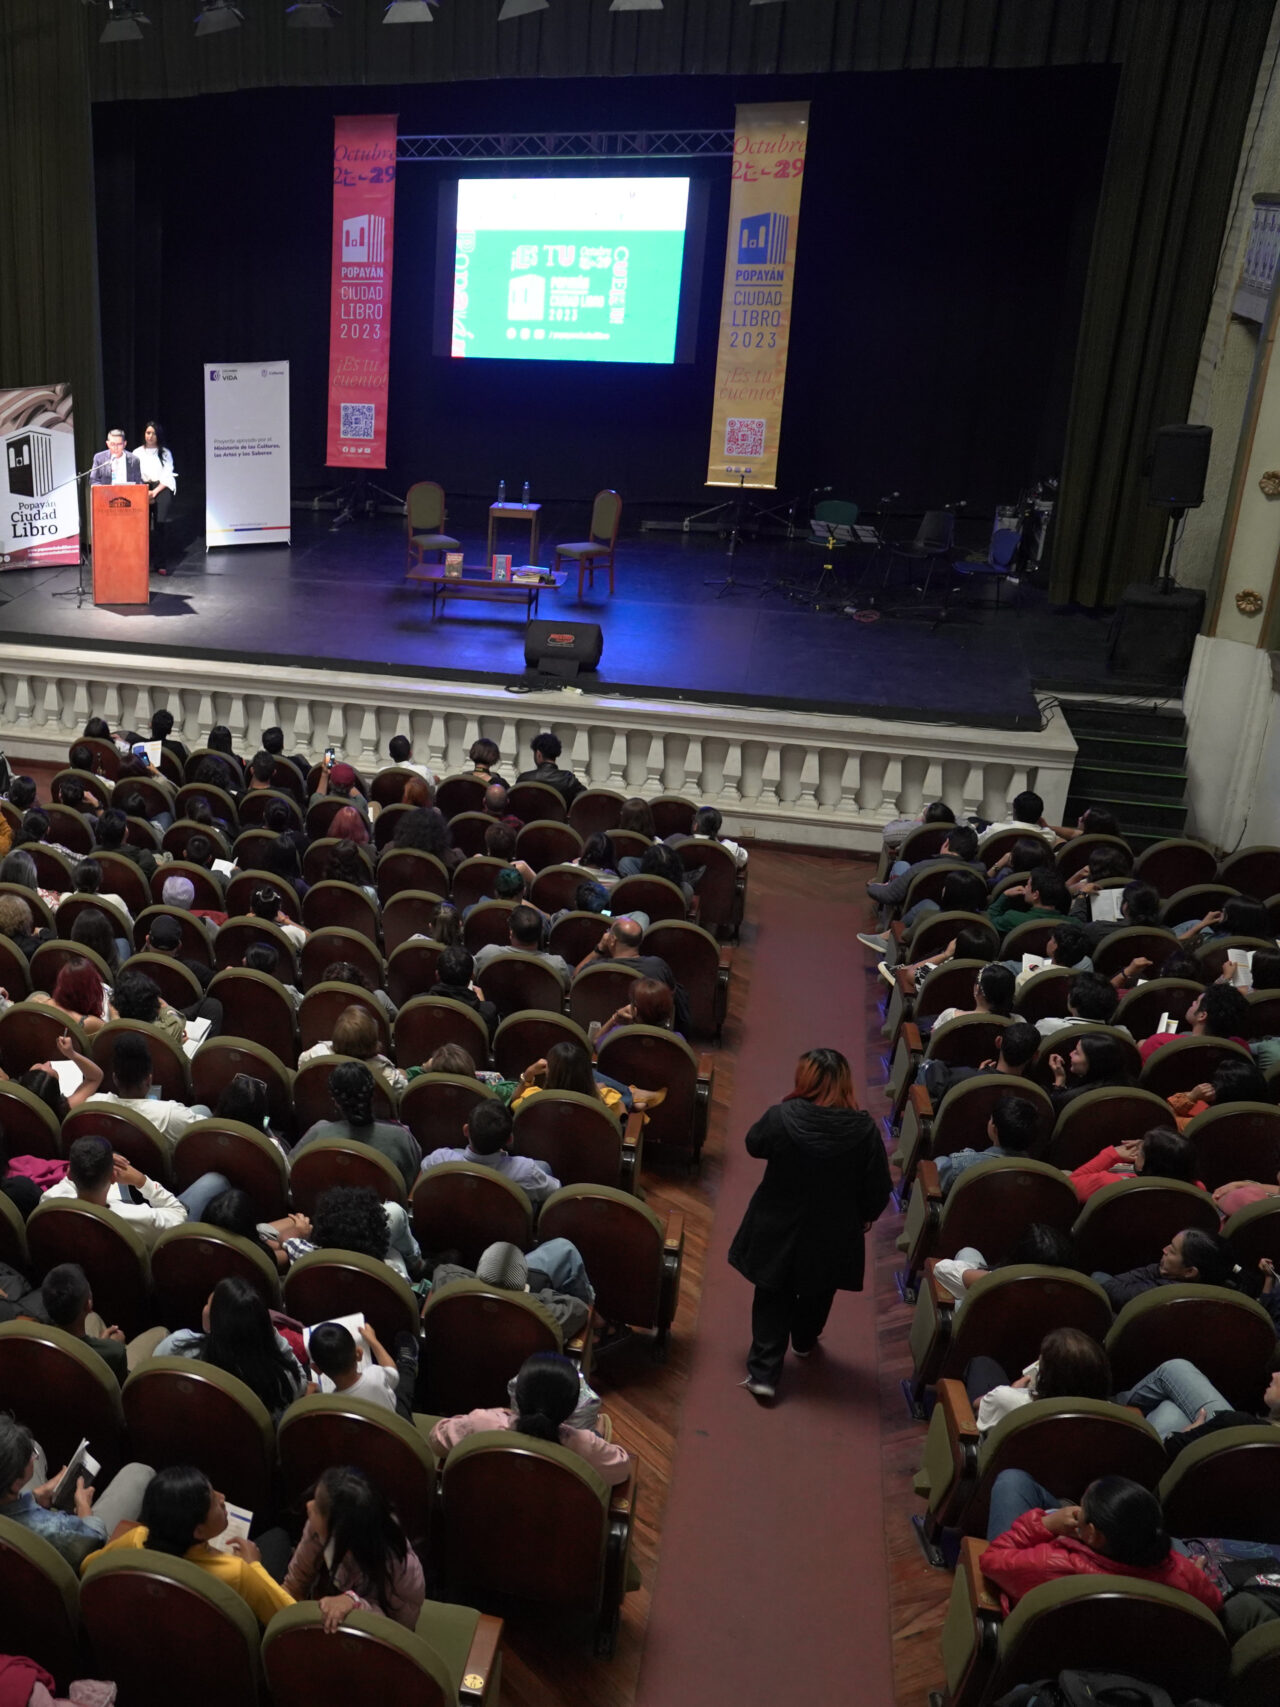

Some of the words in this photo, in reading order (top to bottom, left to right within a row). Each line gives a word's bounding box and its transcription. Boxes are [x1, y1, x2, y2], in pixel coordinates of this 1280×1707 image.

[734, 133, 806, 155] Octubre
[334, 143, 395, 162] Octubre
[543, 245, 576, 267] TU
[341, 265, 384, 278] POPAYÁN
[735, 266, 784, 281] POPAYÁN
[341, 286, 383, 300] CIUDAD
[733, 290, 783, 306] CIUDAD
[341, 303, 383, 319] LIBRO
[732, 310, 781, 327] LIBRO
[340, 323, 381, 339] 2023
[730, 332, 776, 348] 2023
[363, 358, 379, 372] tu
[755, 369, 773, 384] tu
[18, 500, 56, 511] Popayán
[10, 508, 57, 523] Ciudad
[11, 521, 58, 539] Libro
